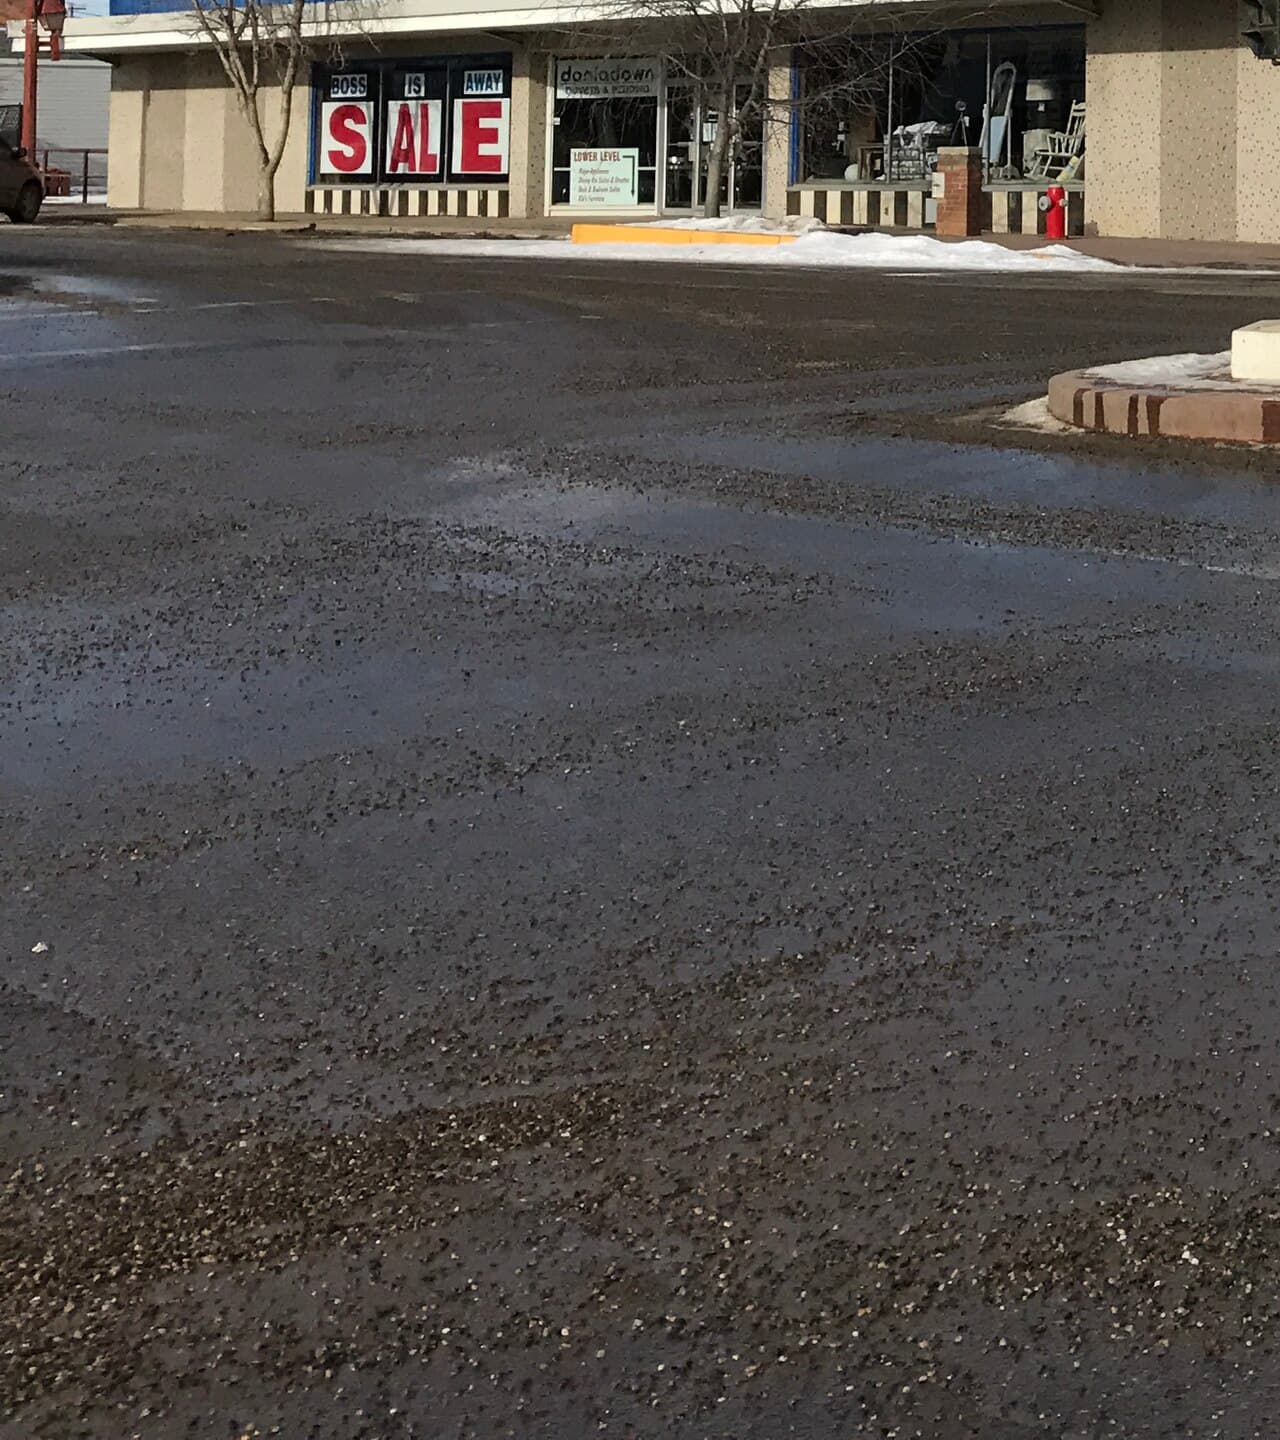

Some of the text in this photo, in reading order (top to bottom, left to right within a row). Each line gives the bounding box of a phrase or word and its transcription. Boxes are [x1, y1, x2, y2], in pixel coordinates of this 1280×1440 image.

[332, 72, 502, 94] BOSS IS AWAY
[328, 101, 502, 172] SALE
[574, 151, 620, 162] LOWER LEVEL
